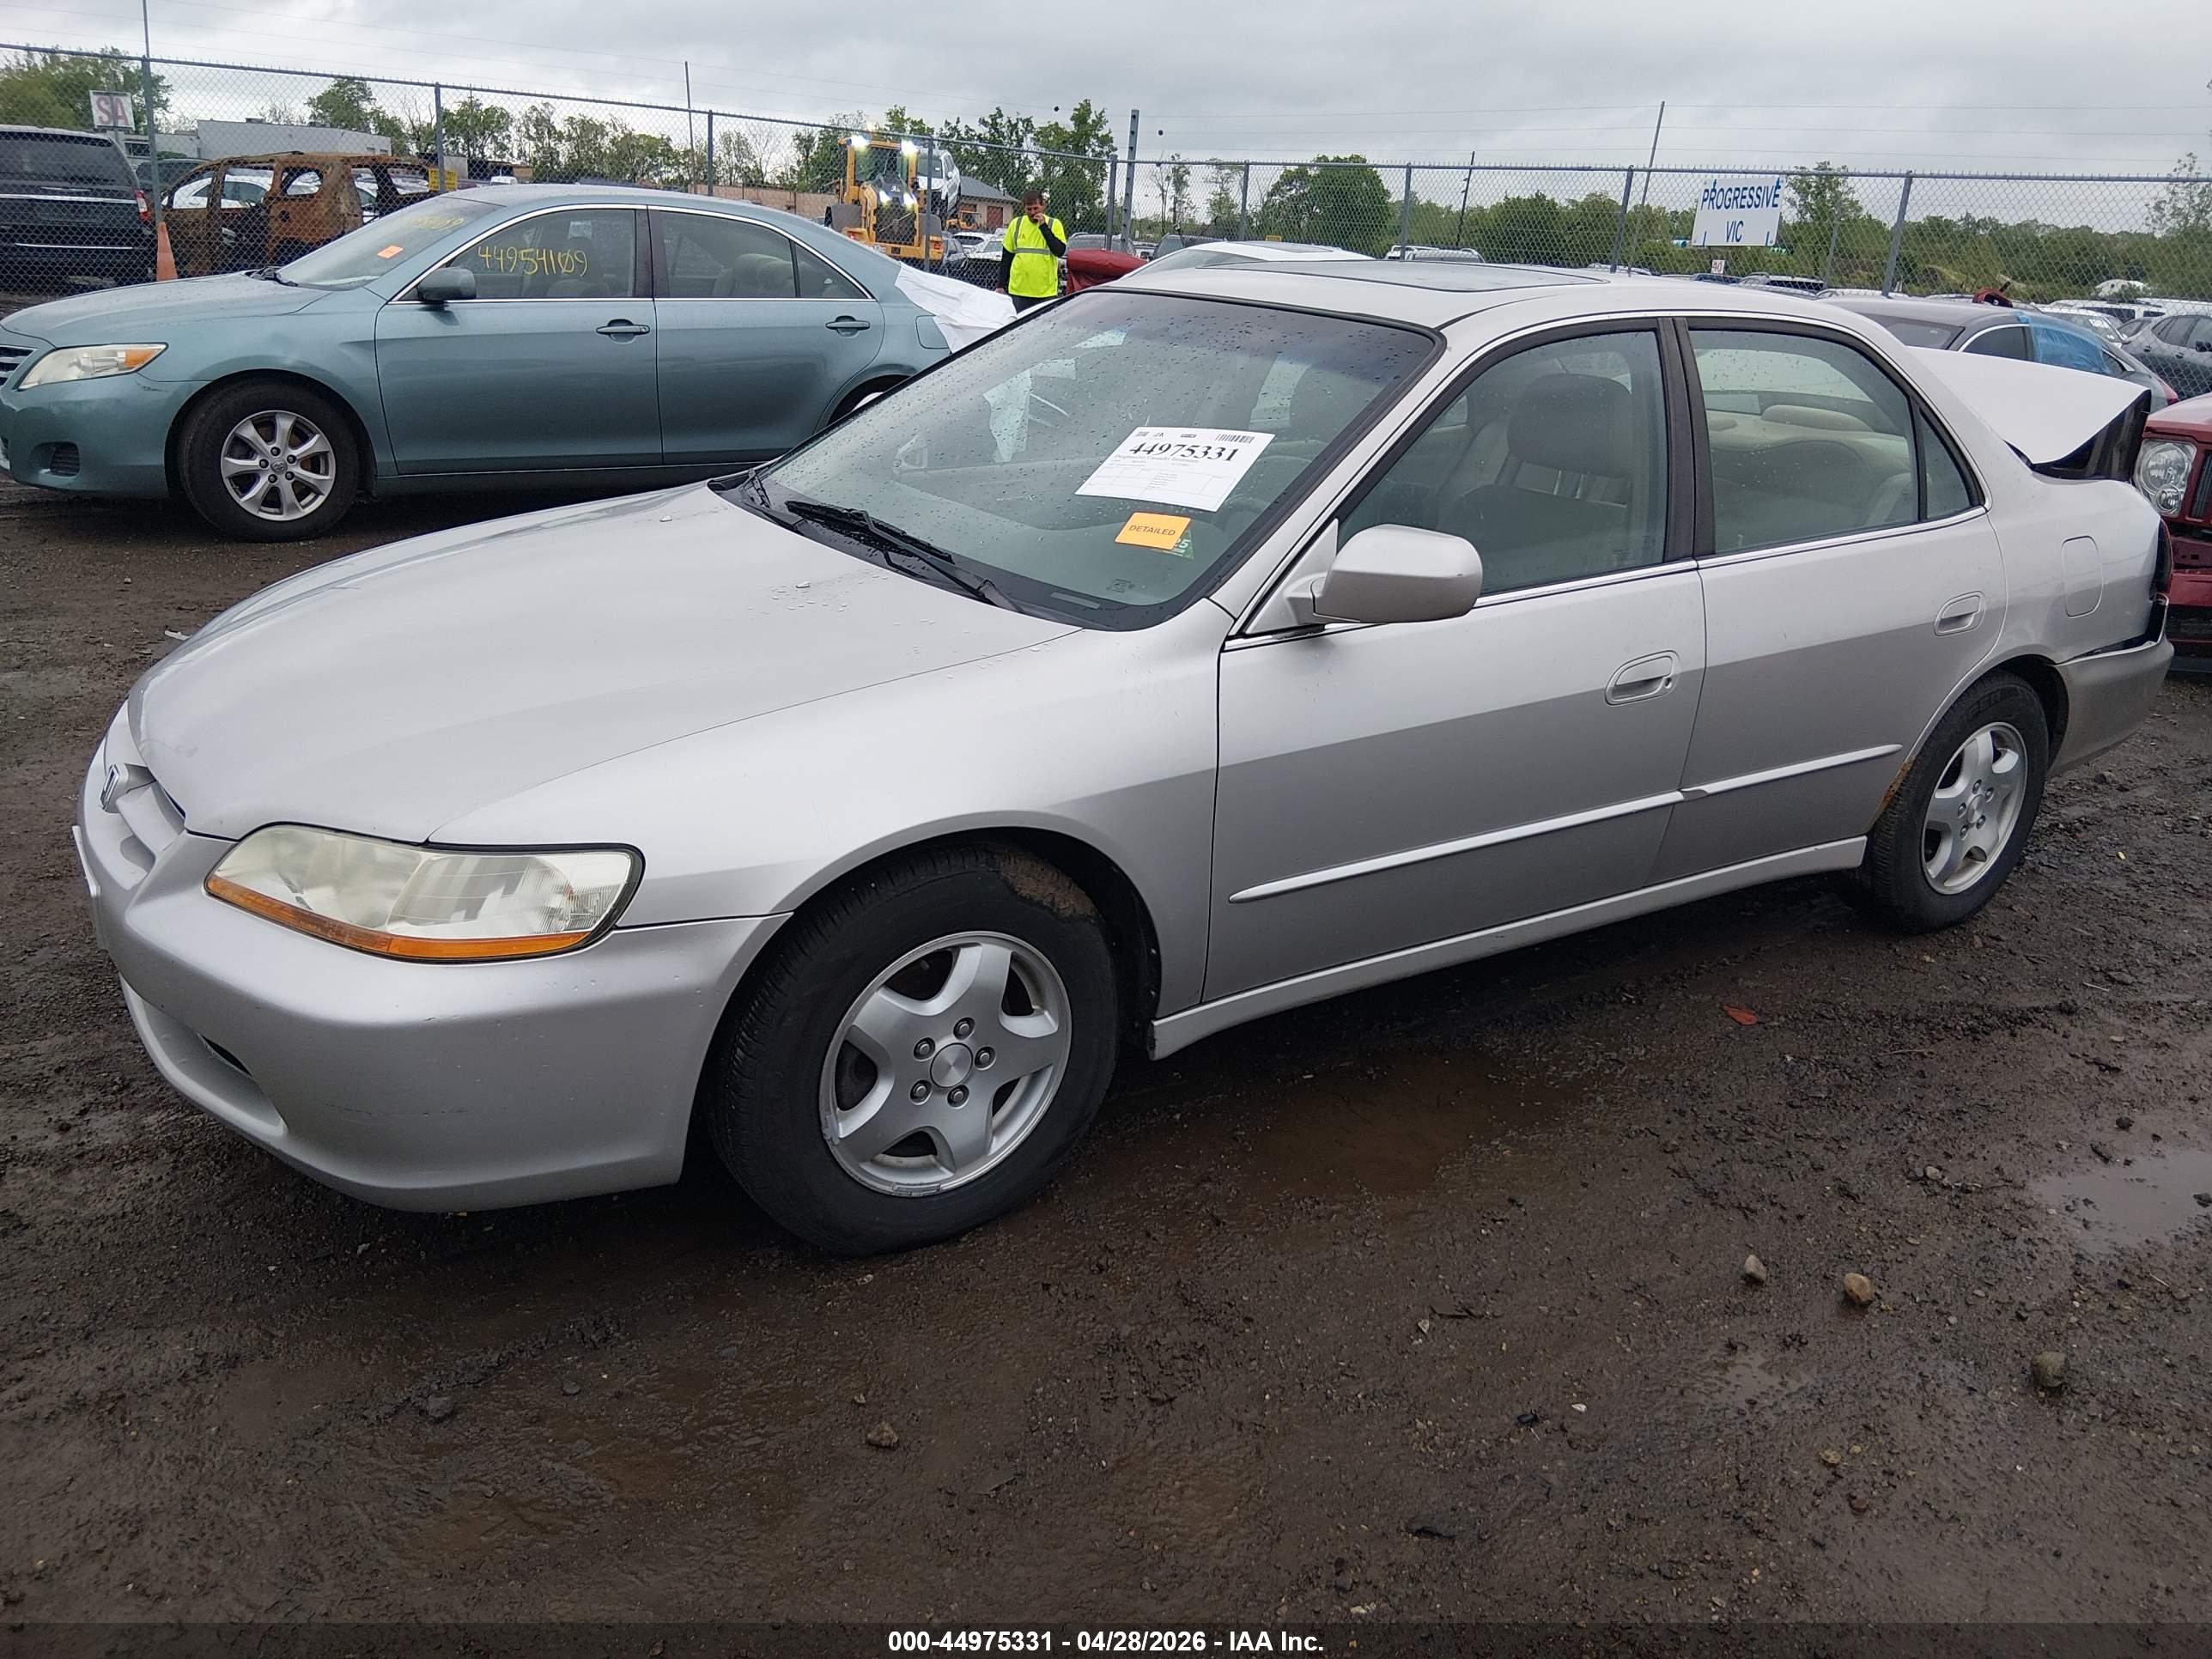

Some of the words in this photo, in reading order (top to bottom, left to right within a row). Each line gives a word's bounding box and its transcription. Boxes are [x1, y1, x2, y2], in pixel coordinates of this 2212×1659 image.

[96, 96, 129, 125] SA
[1701, 185, 1781, 210] PROGRESSIVE
[1726, 221, 1743, 242] VIC
[1129, 442, 1238, 461] 44975331
[1128, 525, 1176, 536] DETAILED
